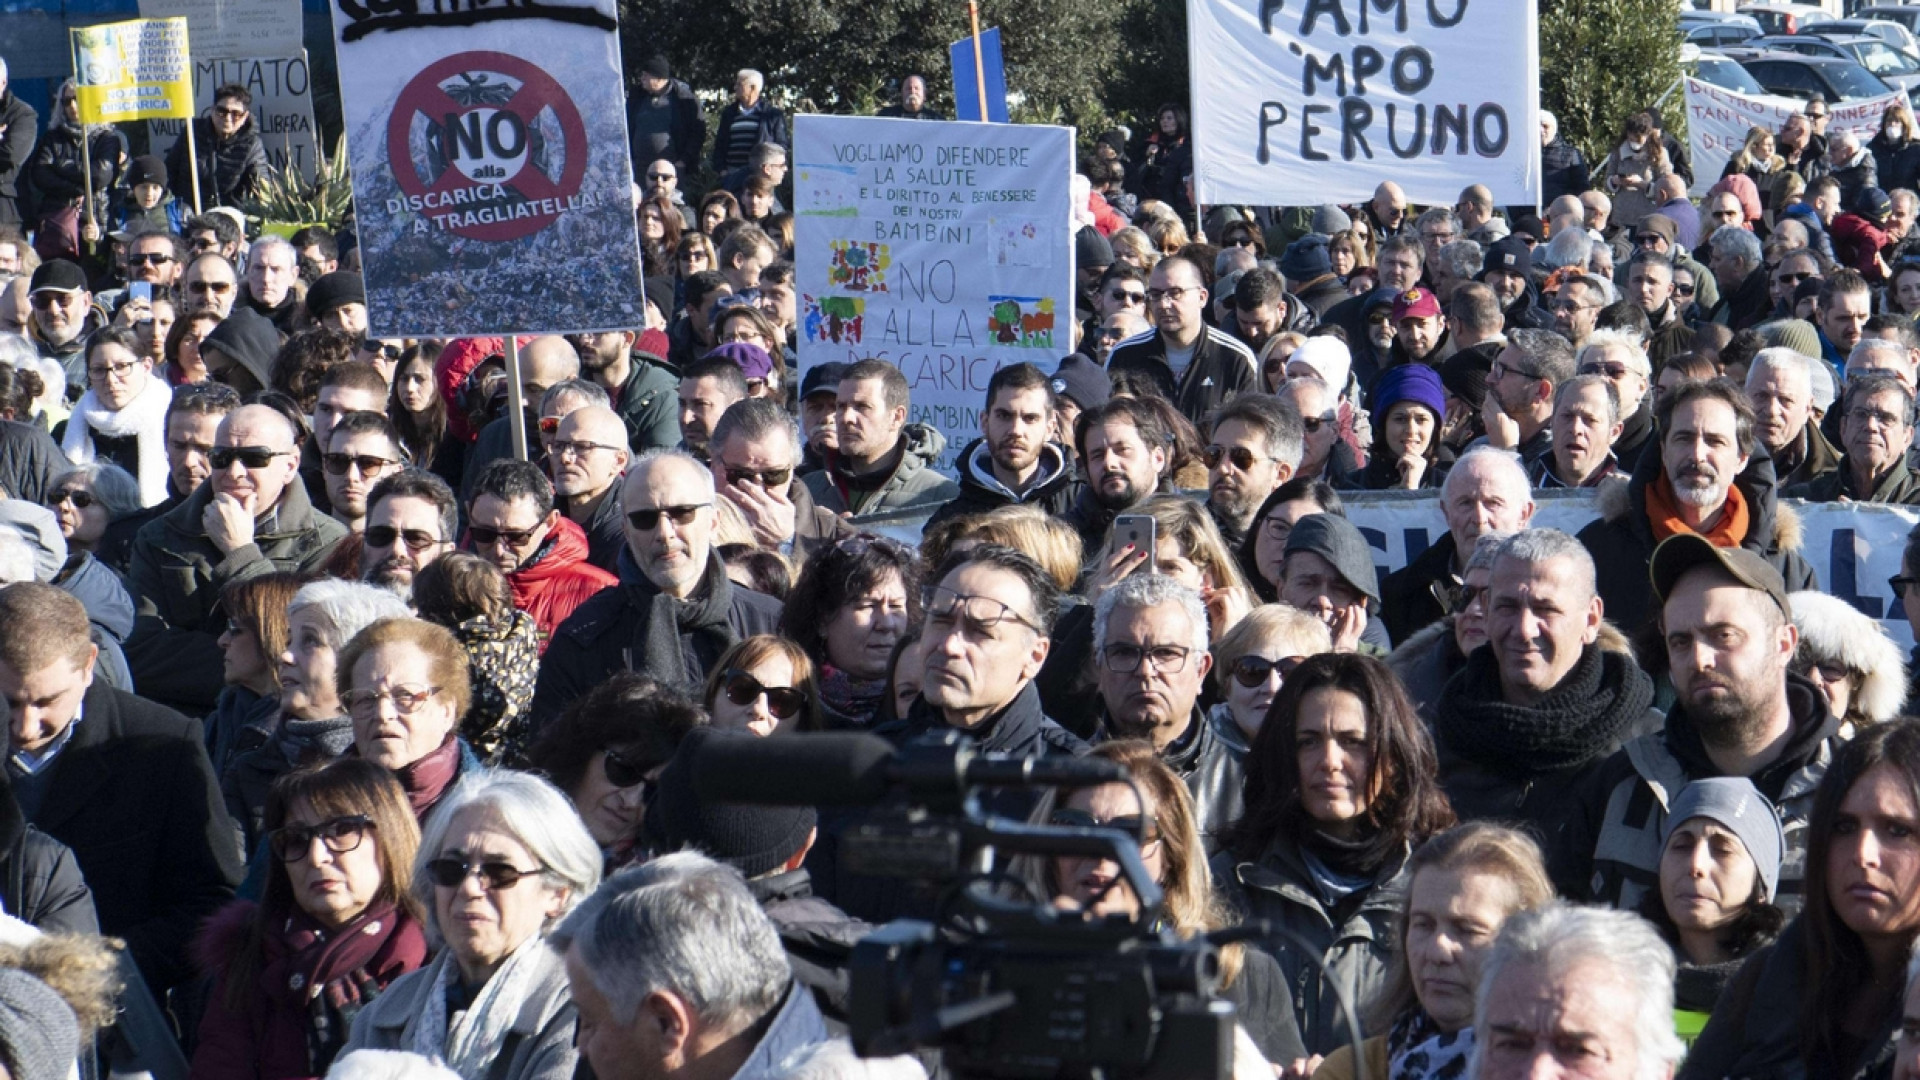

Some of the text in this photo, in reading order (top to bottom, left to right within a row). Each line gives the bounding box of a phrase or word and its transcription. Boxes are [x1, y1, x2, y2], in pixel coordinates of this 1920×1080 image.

[154, 73, 180, 82] VOCE
[129, 85, 163, 97] ALLA
[102, 99, 169, 114] DISCARICA
[259, 104, 311, 134] LIBERA
[443, 110, 527, 160] NO
[1257, 96, 1510, 165] PERUNO
[833, 144, 1030, 168] VOGLIAMO DIFENDERE
[471, 164, 506, 179] alla
[874, 167, 977, 187] LA SALUTE
[386, 184, 507, 215] DISCARICA
[859, 187, 1037, 205] E IL DIRITTO AL BENESSERE
[412, 191, 603, 235] A TRAGLIATELLA!
[893, 205, 963, 220] DEI NOSTRI
[875, 220, 972, 245] BAMBINI
[899, 258, 957, 304] NO
[882, 308, 976, 348] ALLA
[911, 403, 979, 430] BAMBIN
